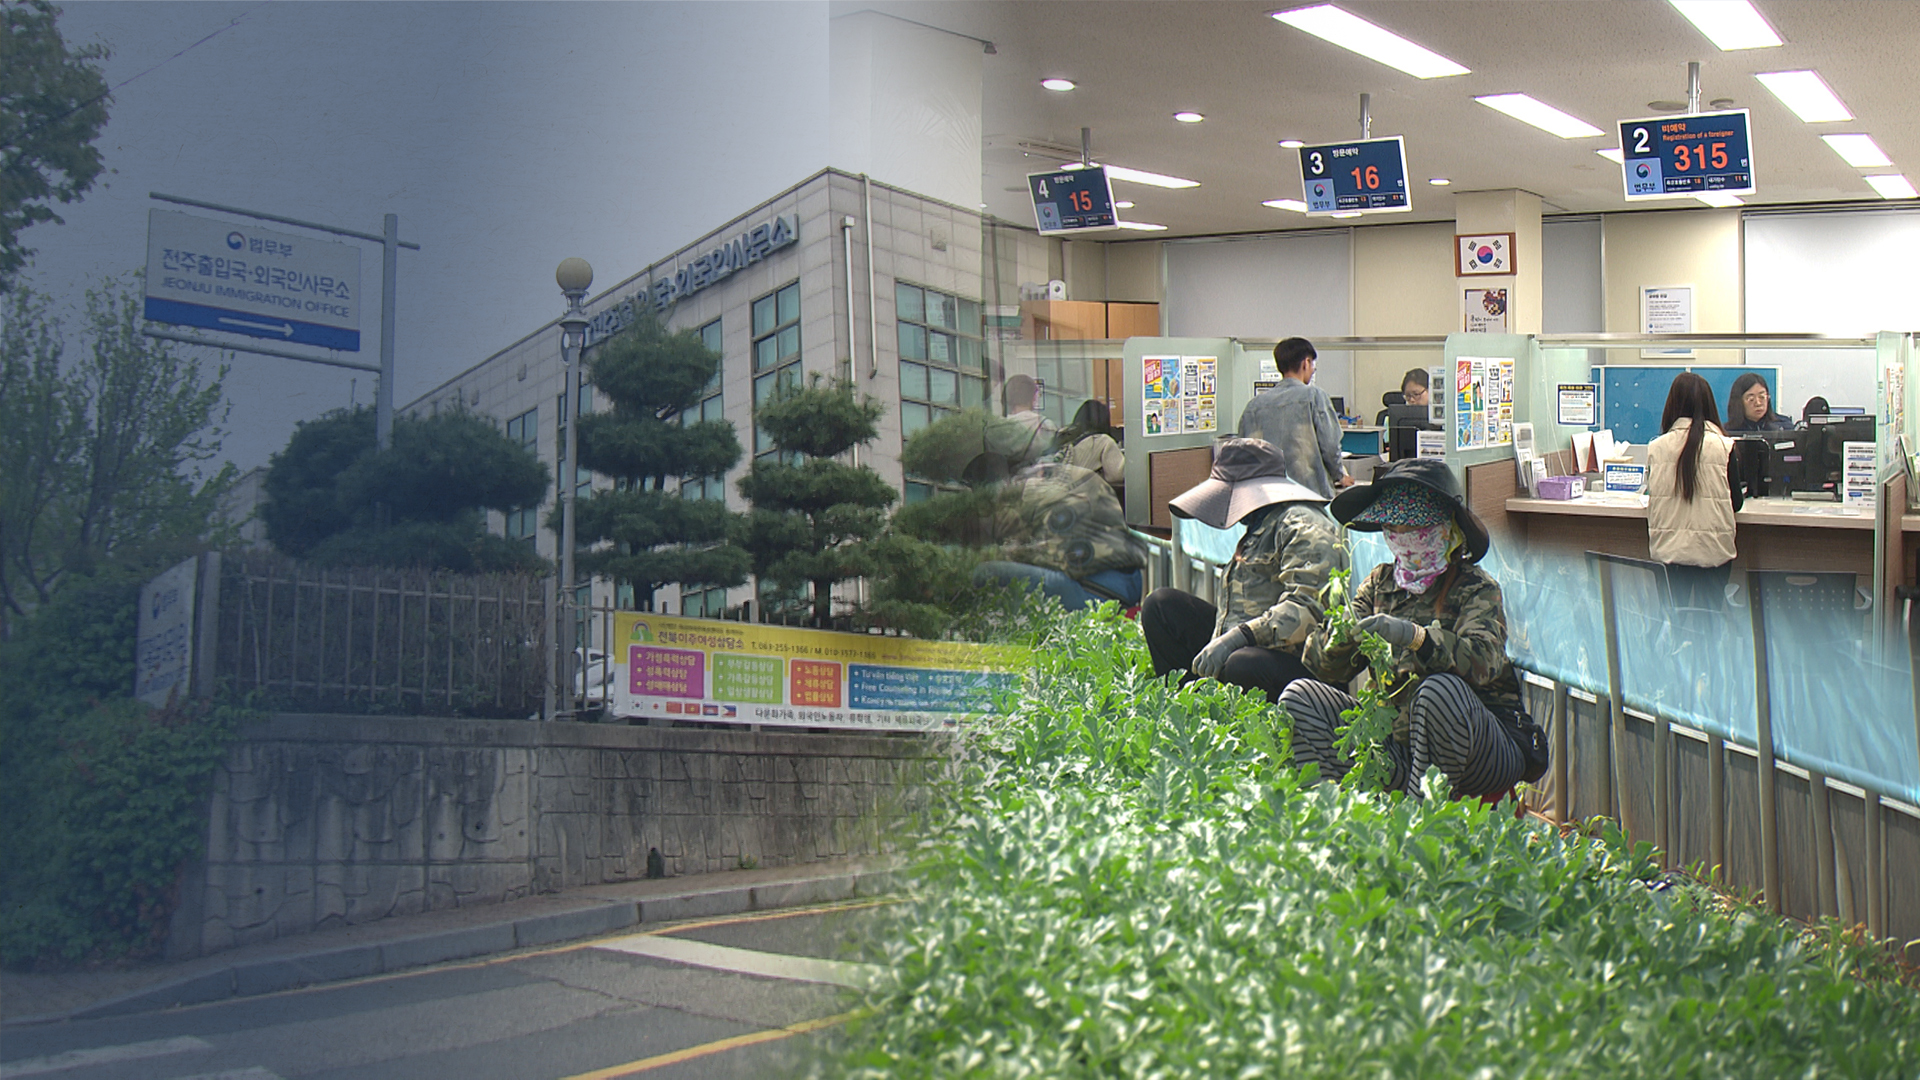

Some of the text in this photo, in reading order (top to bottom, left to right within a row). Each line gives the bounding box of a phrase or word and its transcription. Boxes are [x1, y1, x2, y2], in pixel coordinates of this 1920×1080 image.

[1632, 127, 1651, 153] 2
[1662, 133, 1696, 142] Registration
[1708, 130, 1734, 138] foreigner
[1309, 151, 1324, 175] 3
[1332, 147, 1359, 158] 방문예약
[1673, 142, 1728, 172] 315
[1038, 179, 1050, 198] 4
[1350, 165, 1380, 190] 16
[1634, 183, 1655, 192] 법무부
[1069, 190, 1093, 212] 15
[1312, 200, 1331, 209] 법무부
[249, 237, 292, 257] 법무부
[163, 248, 350, 301] 전주출입국·외국인사무소
[161, 277, 350, 318] JEONJU IMMIGRATION OFFICE
